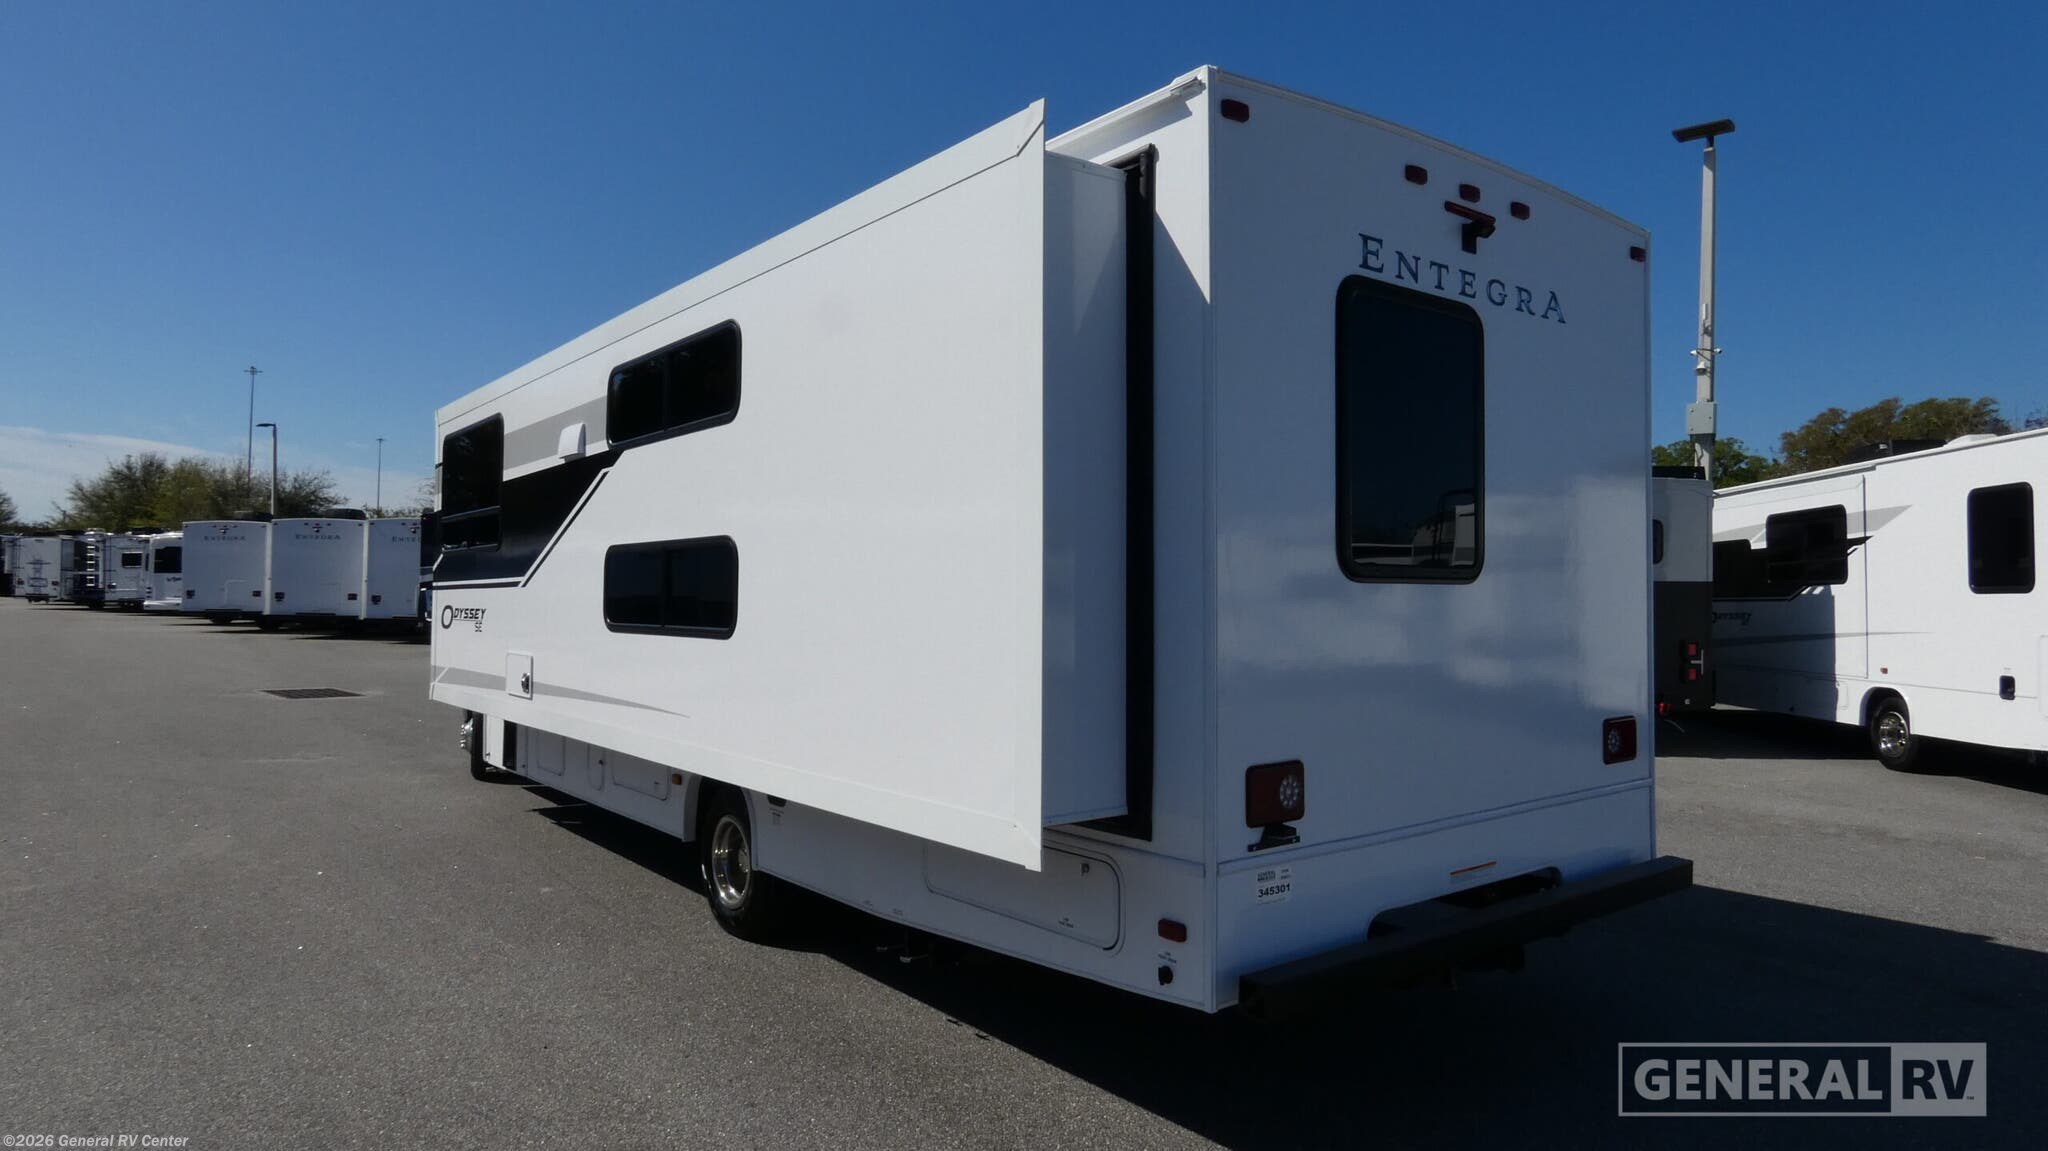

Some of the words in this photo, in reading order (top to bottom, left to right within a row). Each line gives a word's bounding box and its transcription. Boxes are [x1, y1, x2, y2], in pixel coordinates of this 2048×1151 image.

[1358, 233, 1567, 324] ENTEGRA
[441, 604, 487, 629] ODYSSEY
[1257, 883, 1290, 898] 345301
